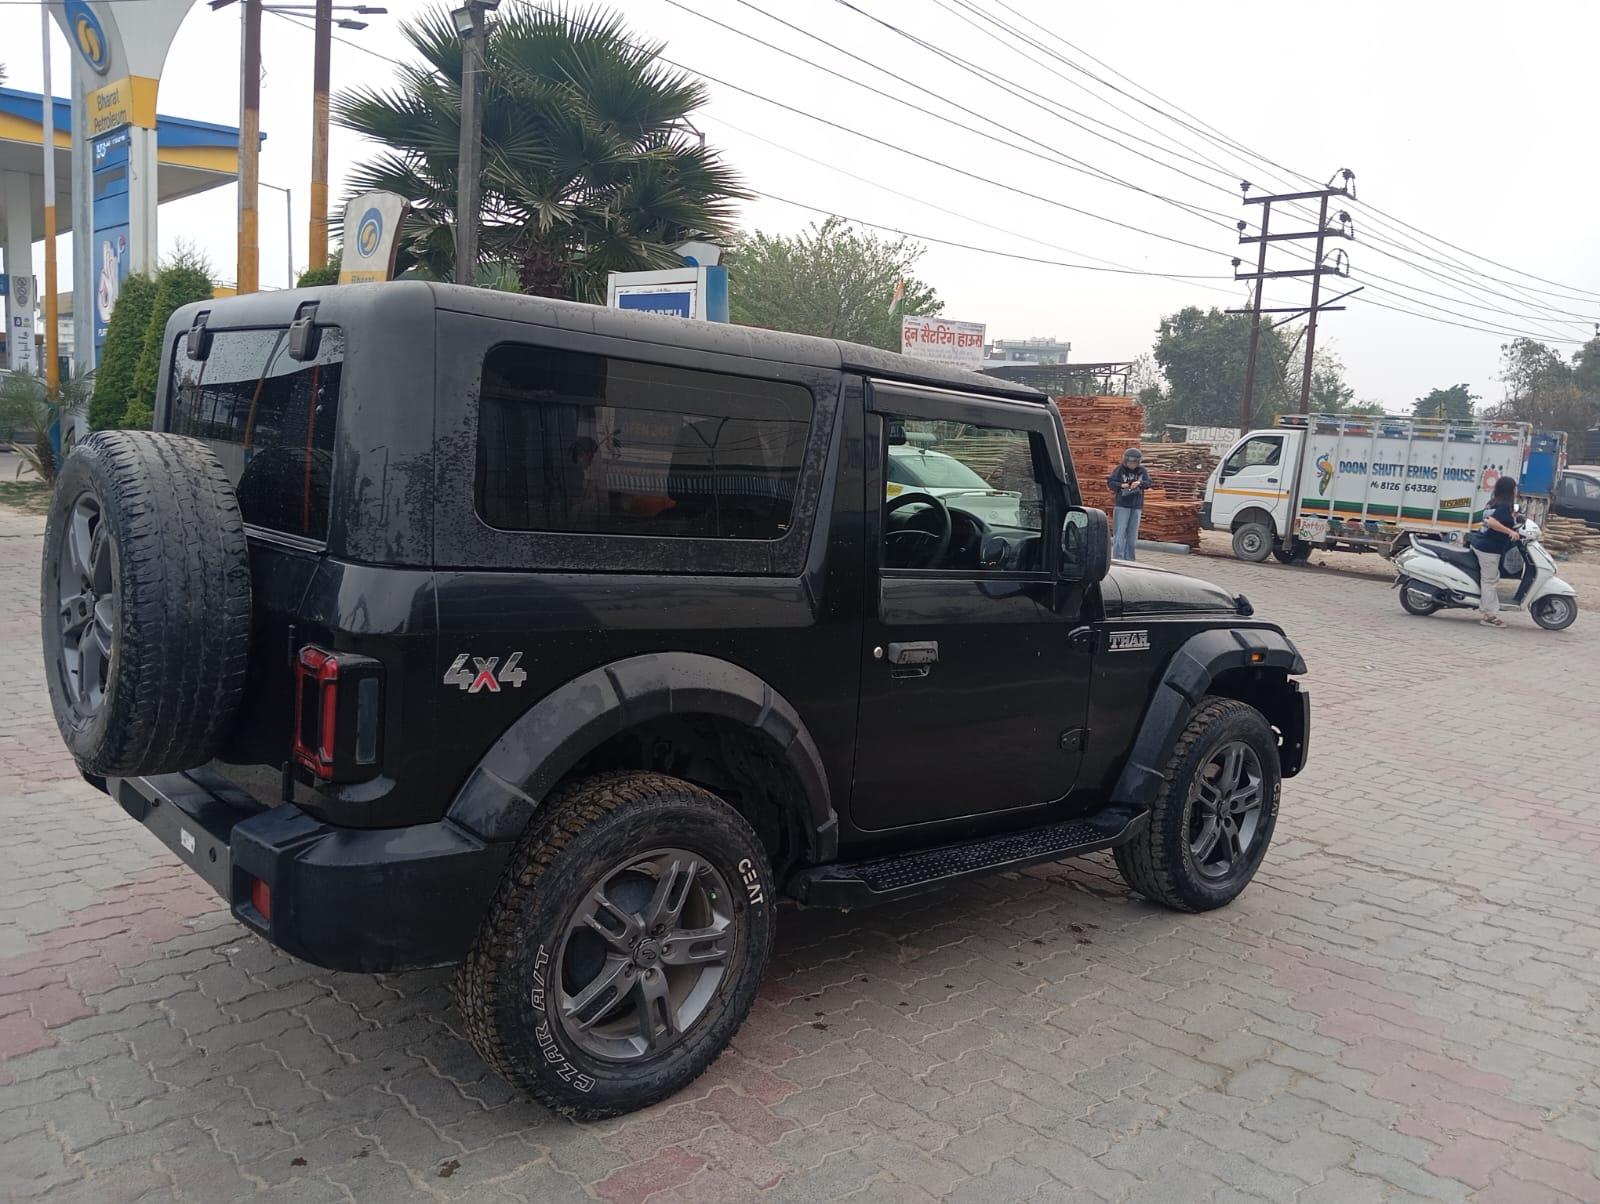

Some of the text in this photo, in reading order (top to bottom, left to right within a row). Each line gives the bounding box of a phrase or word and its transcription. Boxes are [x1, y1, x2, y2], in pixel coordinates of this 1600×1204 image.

[96, 88, 120, 111] Bharat
[94, 109, 127, 134] Petroleum
[904, 326, 918, 348] दून
[1188, 427, 1234, 441] HILLS
[1339, 460, 1368, 475] DOON
[1442, 467, 1476, 483] HOUSE
[1109, 633, 1151, 649] THAR
[738, 858, 763, 905] CEAT
[531, 944, 596, 1093] CZAR A/T
